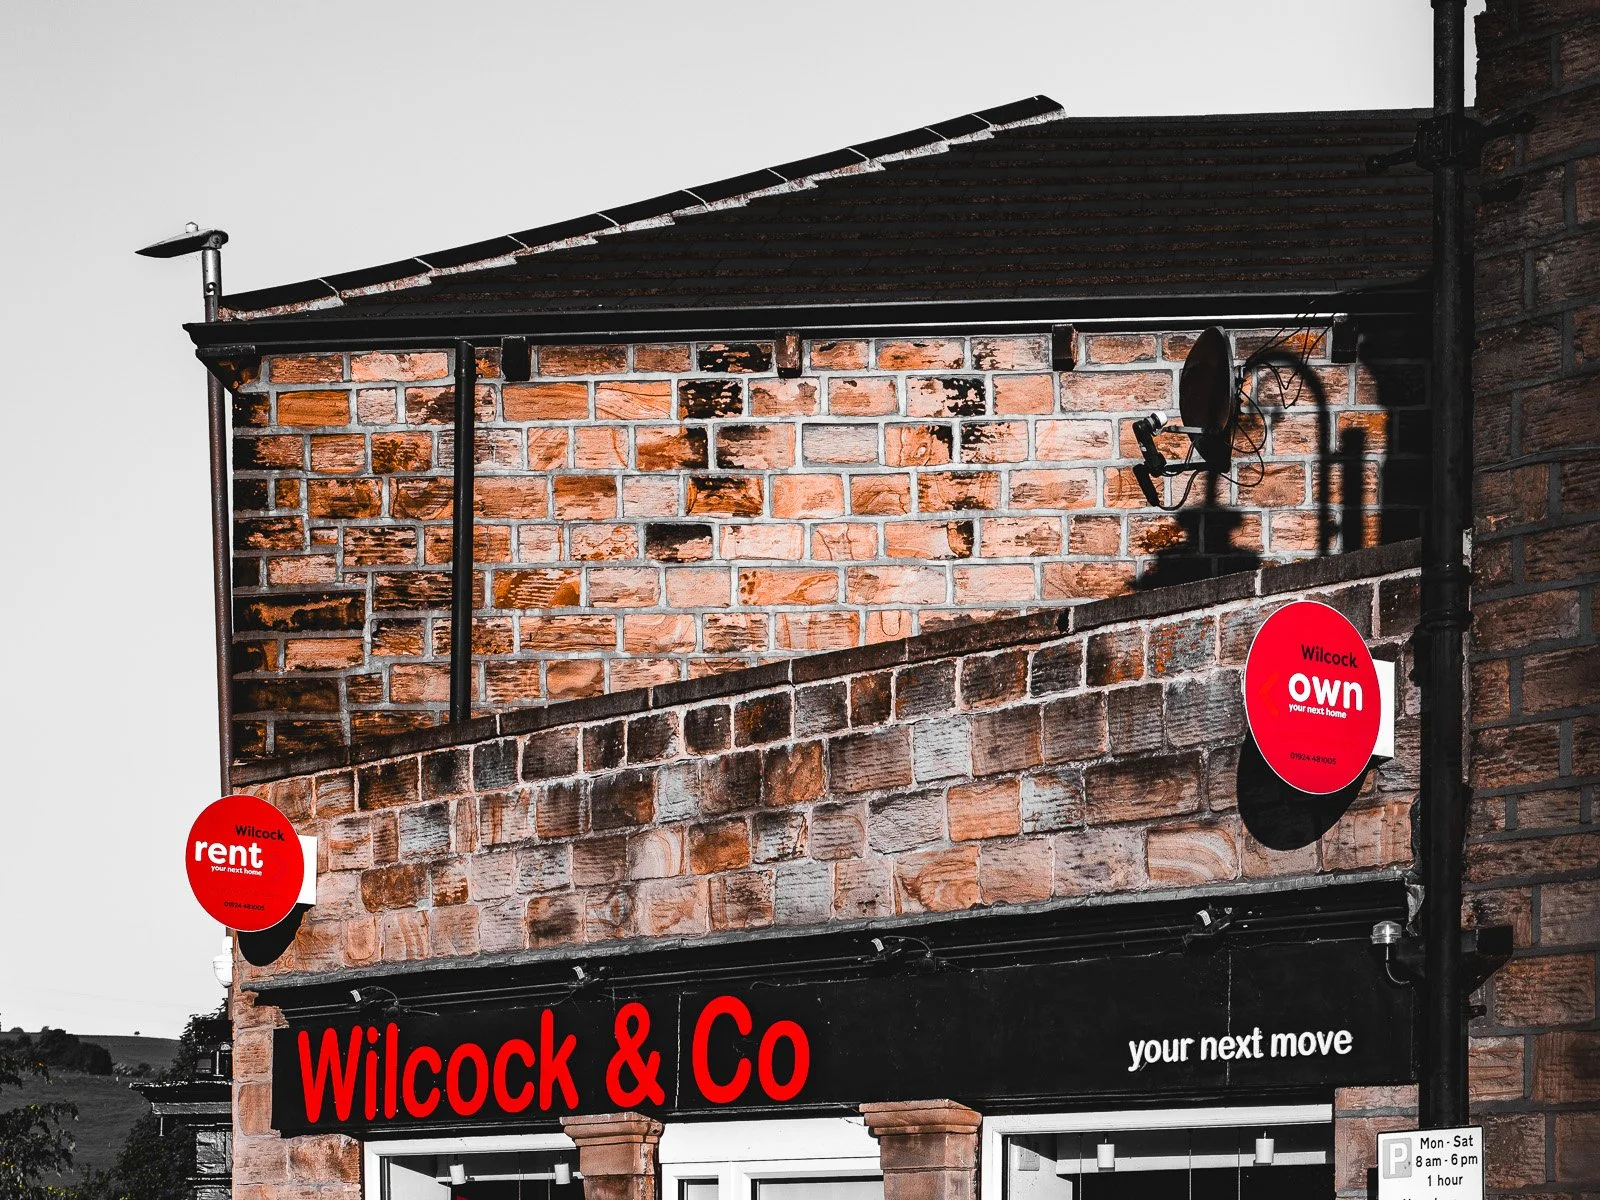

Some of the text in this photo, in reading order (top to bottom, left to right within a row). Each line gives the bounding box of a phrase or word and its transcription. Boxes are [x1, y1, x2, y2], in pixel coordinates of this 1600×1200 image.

[1301, 644, 1358, 668] Wilcock
[1288, 673, 1363, 711] own
[1289, 703, 1347, 719] your next home
[235, 824, 285, 841] Wilcock
[195, 840, 263, 869] rent
[244, 868, 263, 876] home
[298, 995, 810, 1123] Wilcock & Co
[1128, 1027, 1353, 1072] your next move
[1420, 1137, 1443, 1149] Mon
[1453, 1135, 1473, 1147] Sat
[1389, 1143, 1408, 1175] P
[1427, 1175, 1463, 1187] 1 hour
